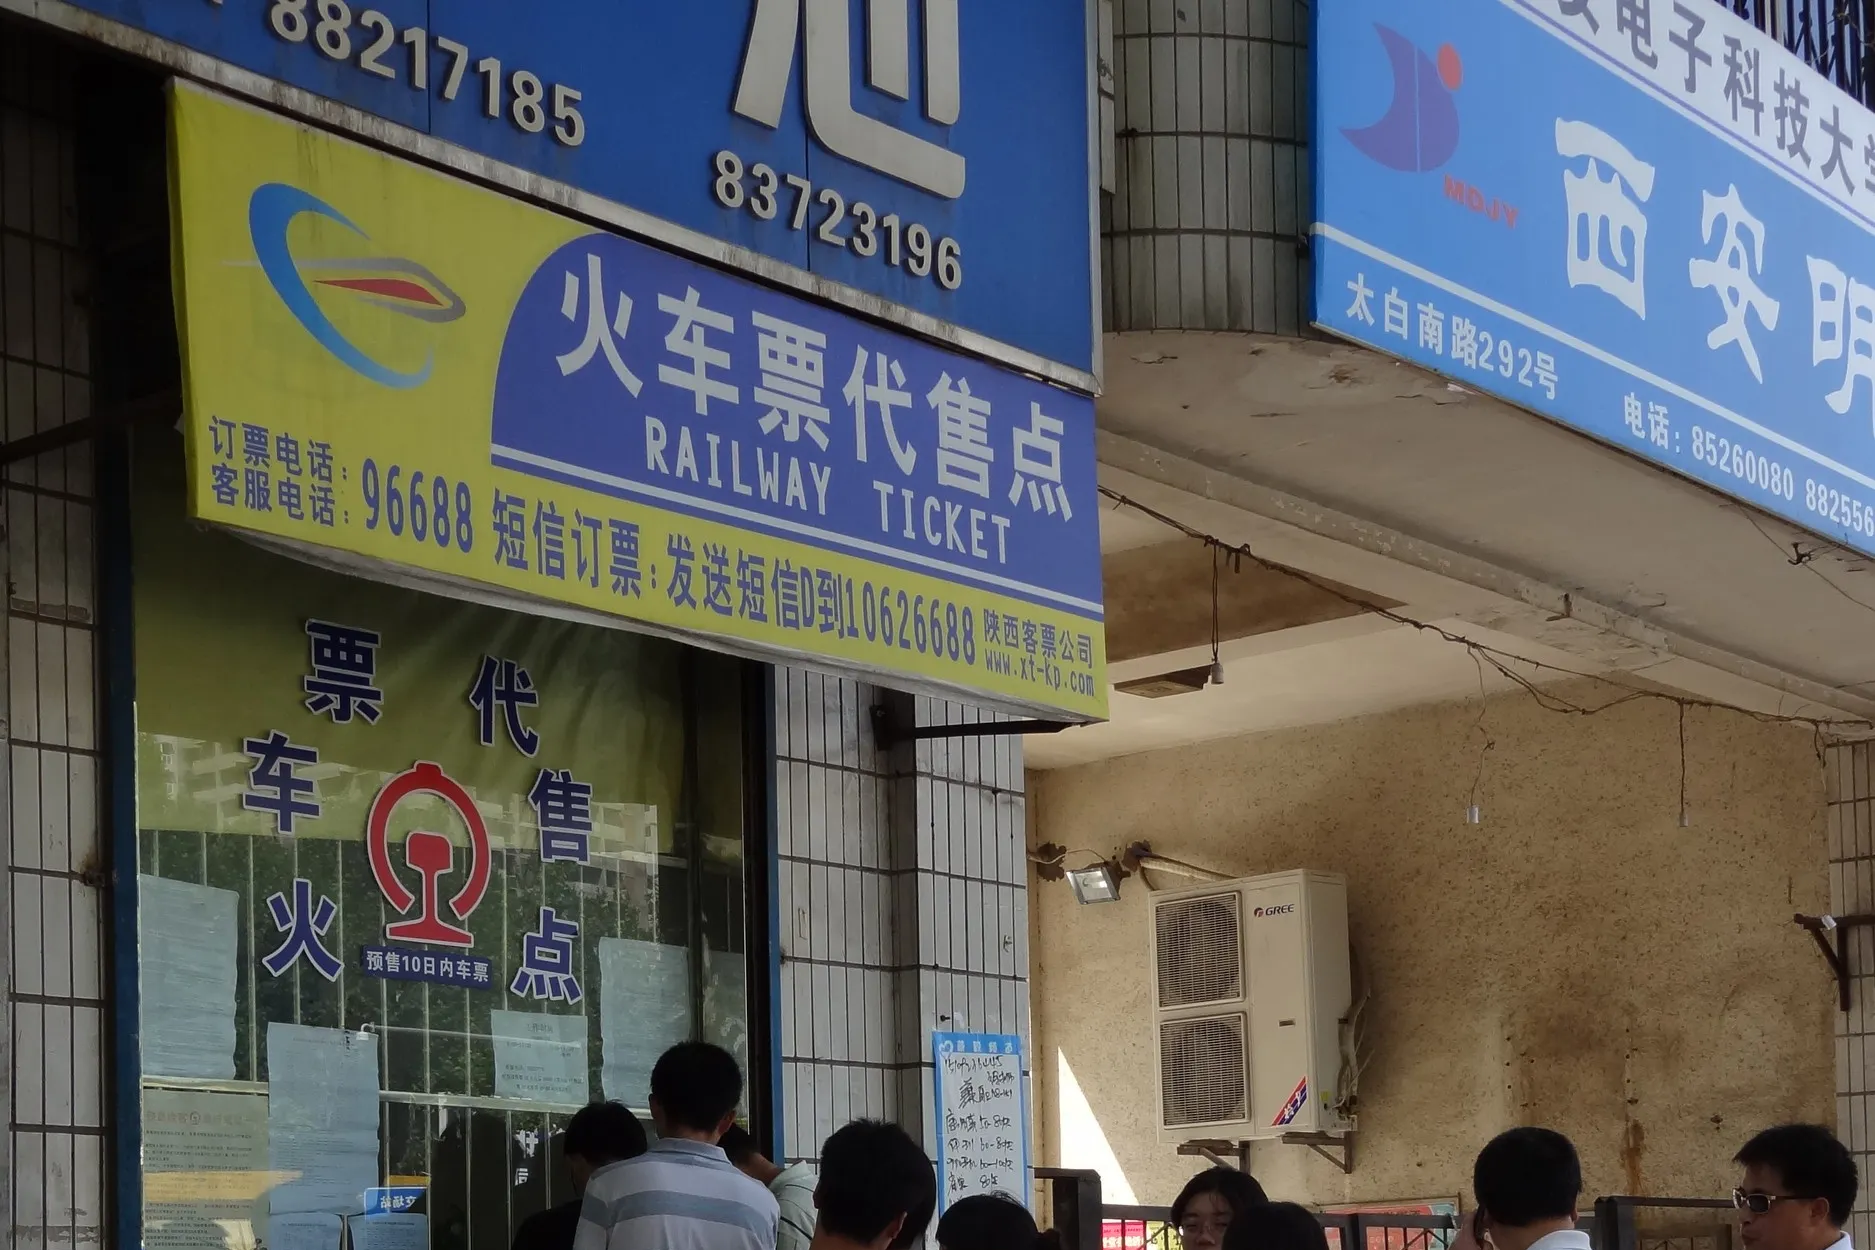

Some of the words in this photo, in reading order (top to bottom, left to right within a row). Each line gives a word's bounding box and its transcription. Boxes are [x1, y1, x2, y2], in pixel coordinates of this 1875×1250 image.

[270, 0, 585, 147] 88217185
[713, 150, 962, 290] 83723196
[1346, 273, 1559, 400] 太白南路292号
[556, 253, 1072, 521] 火车票代售点
[362, 458, 474, 553] 96688
[645, 416, 832, 516] RAILWAY
[873, 480, 1011, 565] TICKET
[1691, 425, 1795, 501] 85260080
[983, 608, 1092, 669] 陕西客票公司
[985, 648, 1094, 697] www.xt-kp.com
[1265, 904, 1295, 916] GREE
[366, 951, 489, 982] 预售10日内车票
